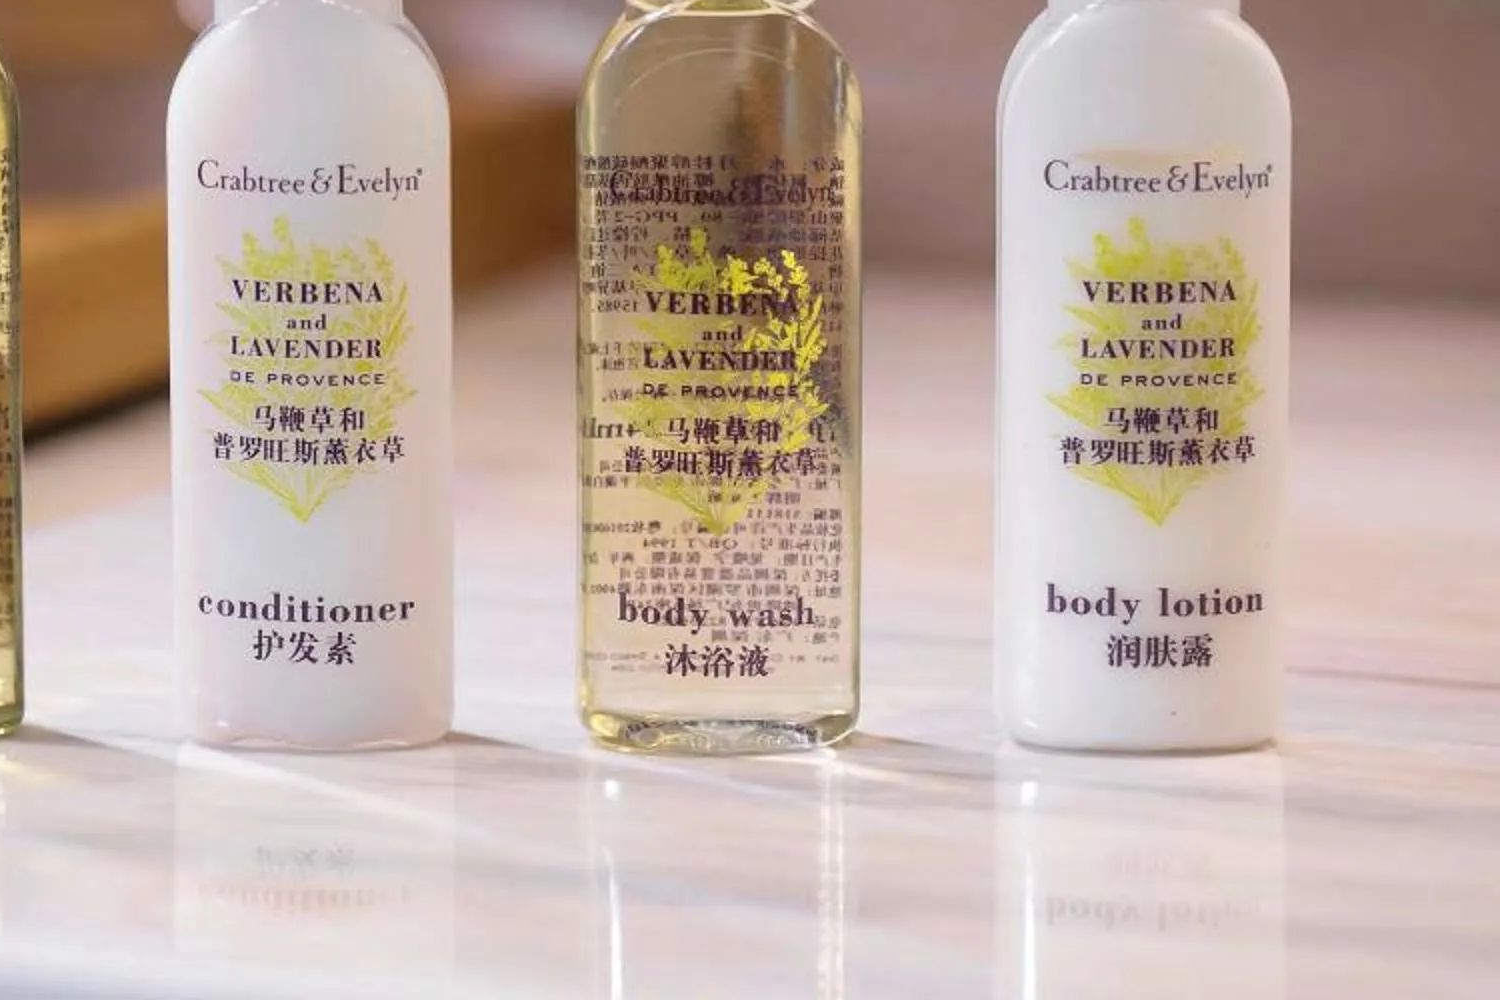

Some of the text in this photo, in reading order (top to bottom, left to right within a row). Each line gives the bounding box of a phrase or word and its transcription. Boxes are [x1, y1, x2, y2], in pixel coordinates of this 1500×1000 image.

[197, 159, 420, 200] Crabtree & Evelyn
[1044, 159, 1271, 199] Crabtree & Evelyn
[231, 278, 384, 304] VERBENA
[645, 290, 798, 316] VERBENA
[1083, 279, 1238, 304] VERBENA
[286, 313, 327, 331] and
[702, 325, 743, 342] and
[1141, 313, 1183, 331] and
[230, 335, 382, 360] LAVENDER
[643, 347, 796, 371] LAVENDER
[1080, 337, 1236, 360] LAVENDER
[230, 370, 385, 387] DE PROVENCE
[643, 383, 668, 397] DE
[682, 383, 798, 399] PROVENCE
[1080, 372, 1238, 388] DE PROVENCE
[253, 405, 365, 434] 马鞭草和
[668, 415, 781, 445] 马鞭草和
[1105, 406, 1219, 435] 马鞭草和
[213, 431, 405, 466] 普罗旺斯薰衣草
[625, 446, 816, 478] 普罗旺斯薰衣草
[1060, 435, 1256, 467] 普罗旺斯薰衣草
[198, 592, 415, 624] conditioner
[618, 592, 815, 634] body wash
[1046, 583, 1264, 625] body lotion
[252, 628, 357, 665] 护发素
[665, 643, 770, 678] 沐浴液
[1107, 633, 1214, 669] 润肤露
